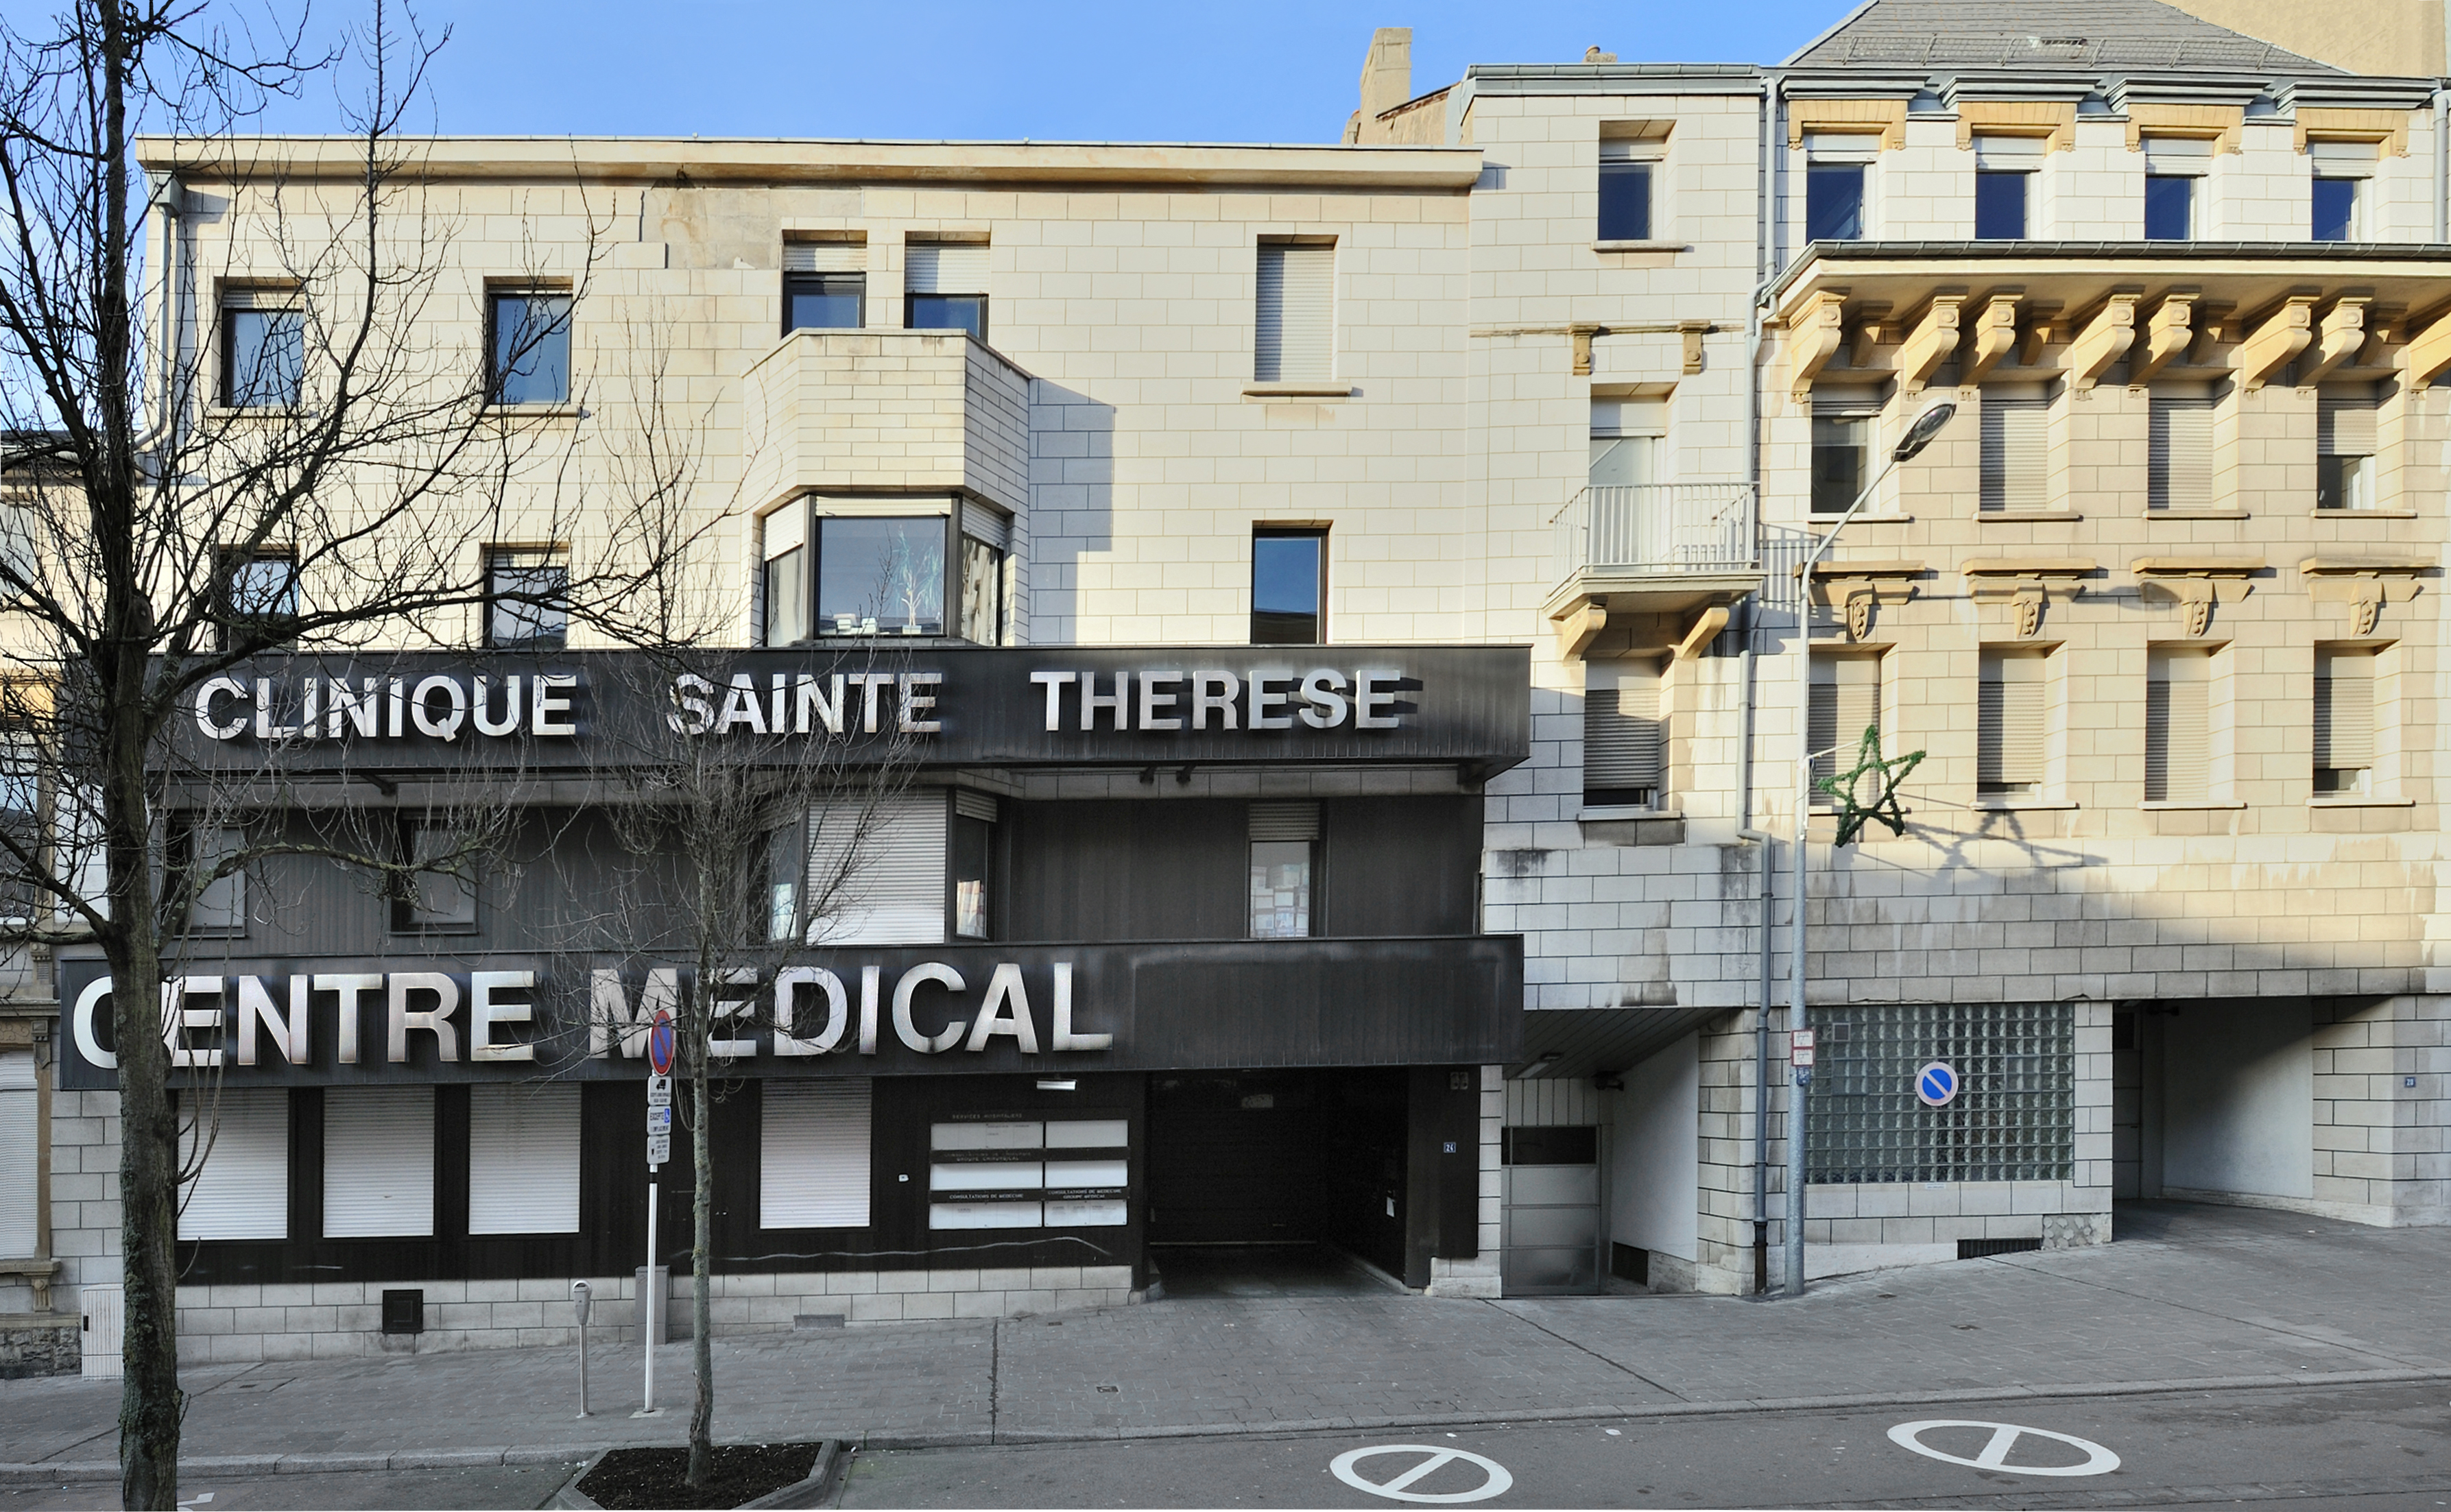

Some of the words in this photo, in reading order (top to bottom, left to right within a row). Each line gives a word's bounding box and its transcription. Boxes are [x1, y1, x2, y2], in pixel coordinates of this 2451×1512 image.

[195, 675, 577, 742] CLINIQUE
[666, 673, 942, 735] SAINTE
[1030, 669, 1400, 732] THERESE
[589, 963, 1114, 1059] MEDICAL
